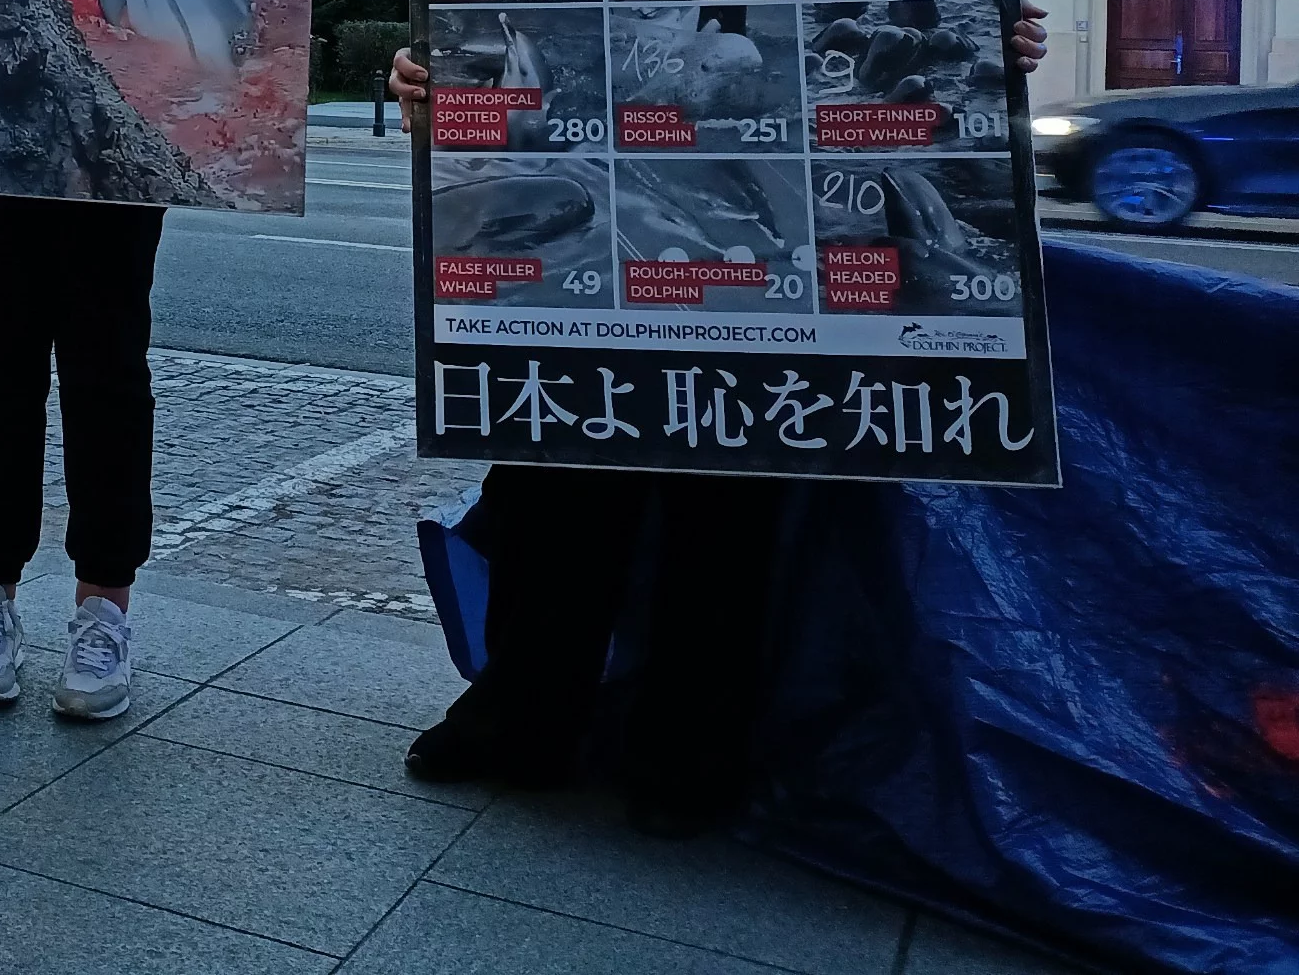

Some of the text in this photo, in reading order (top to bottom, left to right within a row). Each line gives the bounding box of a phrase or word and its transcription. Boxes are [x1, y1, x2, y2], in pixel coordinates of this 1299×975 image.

[622, 35, 685, 81] 136
[437, 93, 535, 105] PANTROPICAL
[436, 111, 500, 123] SPOTTED
[624, 111, 678, 123] RISSO'S
[820, 109, 937, 122] SHORT-FINNED
[548, 118, 604, 142] 280
[740, 118, 788, 142] 251
[953, 113, 1001, 138] 101
[437, 129, 500, 141] DOLPHIN
[624, 129, 692, 142] DOLPHIN
[821, 128, 927, 141] PILOT WHALE
[819, 171, 885, 215] 210
[828, 253, 890, 265] MELON-
[440, 262, 535, 276] FALSE KILLER
[630, 266, 764, 282] ROUGH-TOOTHED
[562, 271, 601, 295] 49
[830, 271, 896, 284] HEADED
[440, 281, 493, 294] WHALE
[631, 286, 699, 299] DOLPHIN
[764, 274, 804, 299] 20
[950, 275, 1016, 301] 300
[831, 290, 889, 304] WHALE
[446, 318, 816, 343] TAKE ACTION AT DOLPHINPROJECT.COM
[913, 341, 960, 351] DOLPHIN
